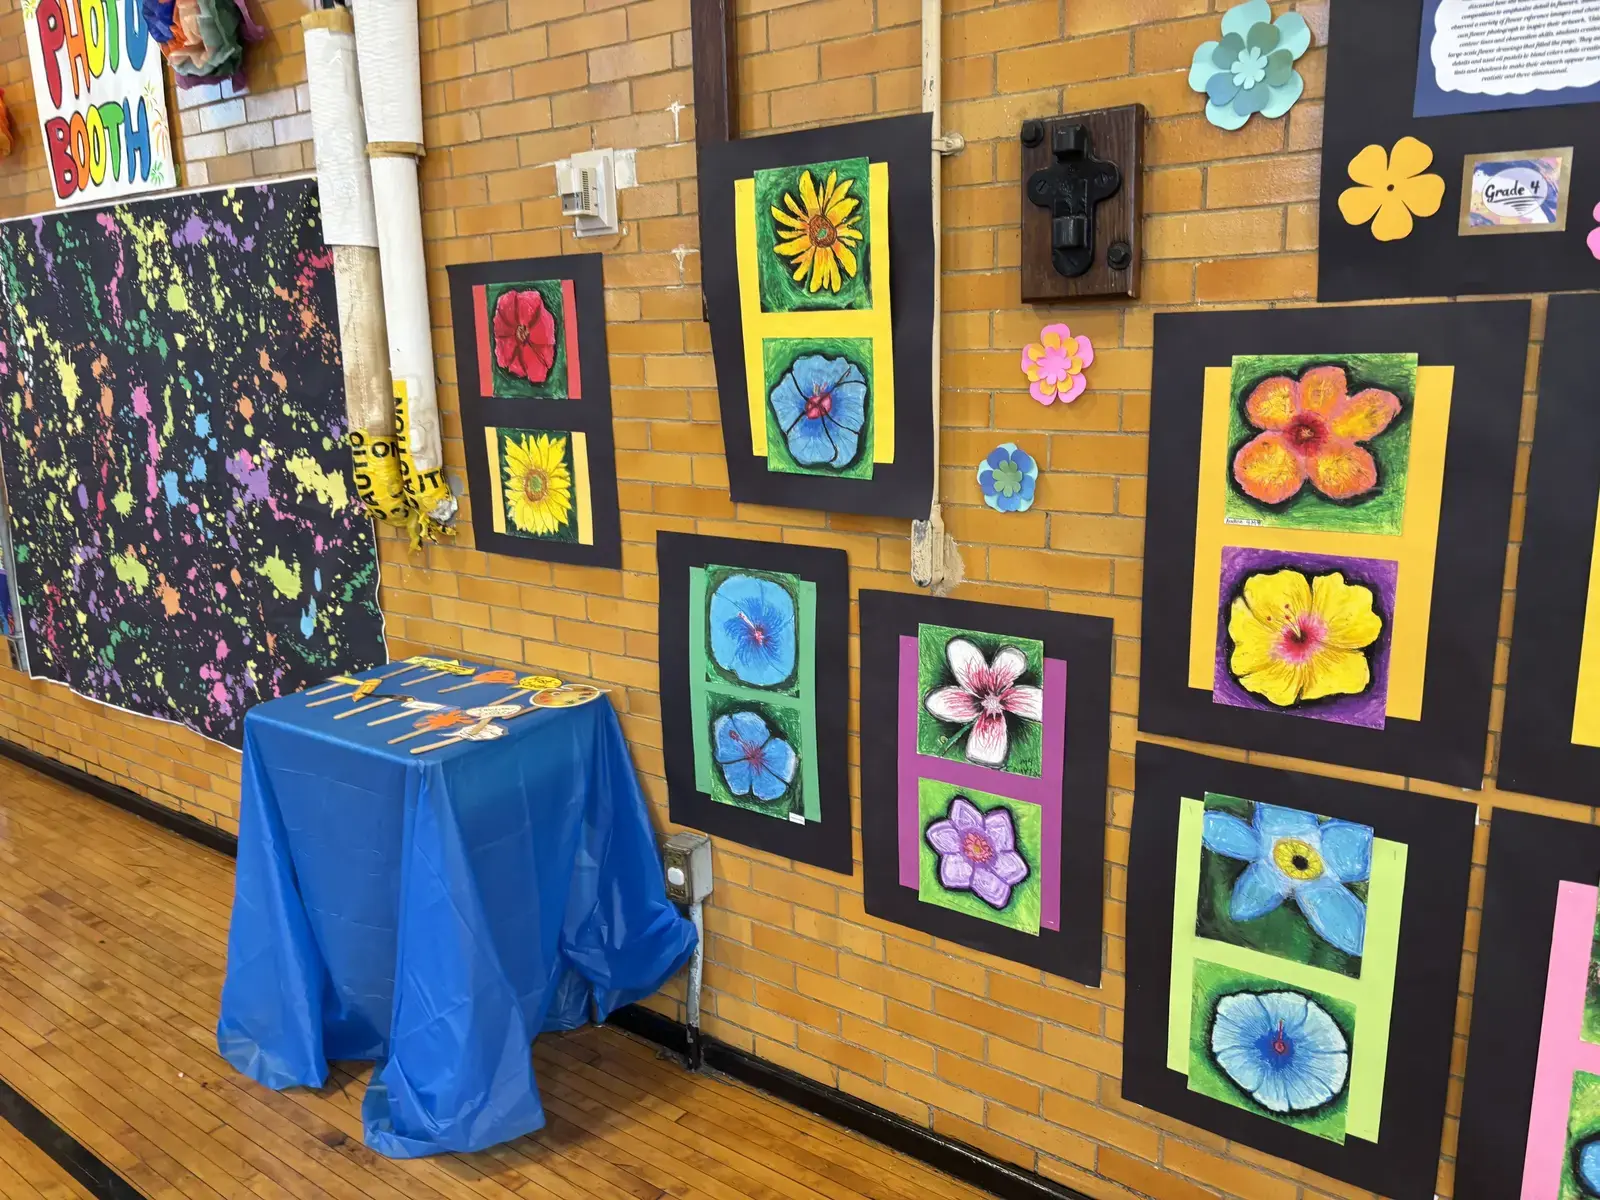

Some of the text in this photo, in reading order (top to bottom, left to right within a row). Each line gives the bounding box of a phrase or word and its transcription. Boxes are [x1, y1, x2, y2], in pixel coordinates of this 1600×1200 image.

[45, 96, 151, 199] BOOTH
[1485, 180, 1540, 203] Grade 4
